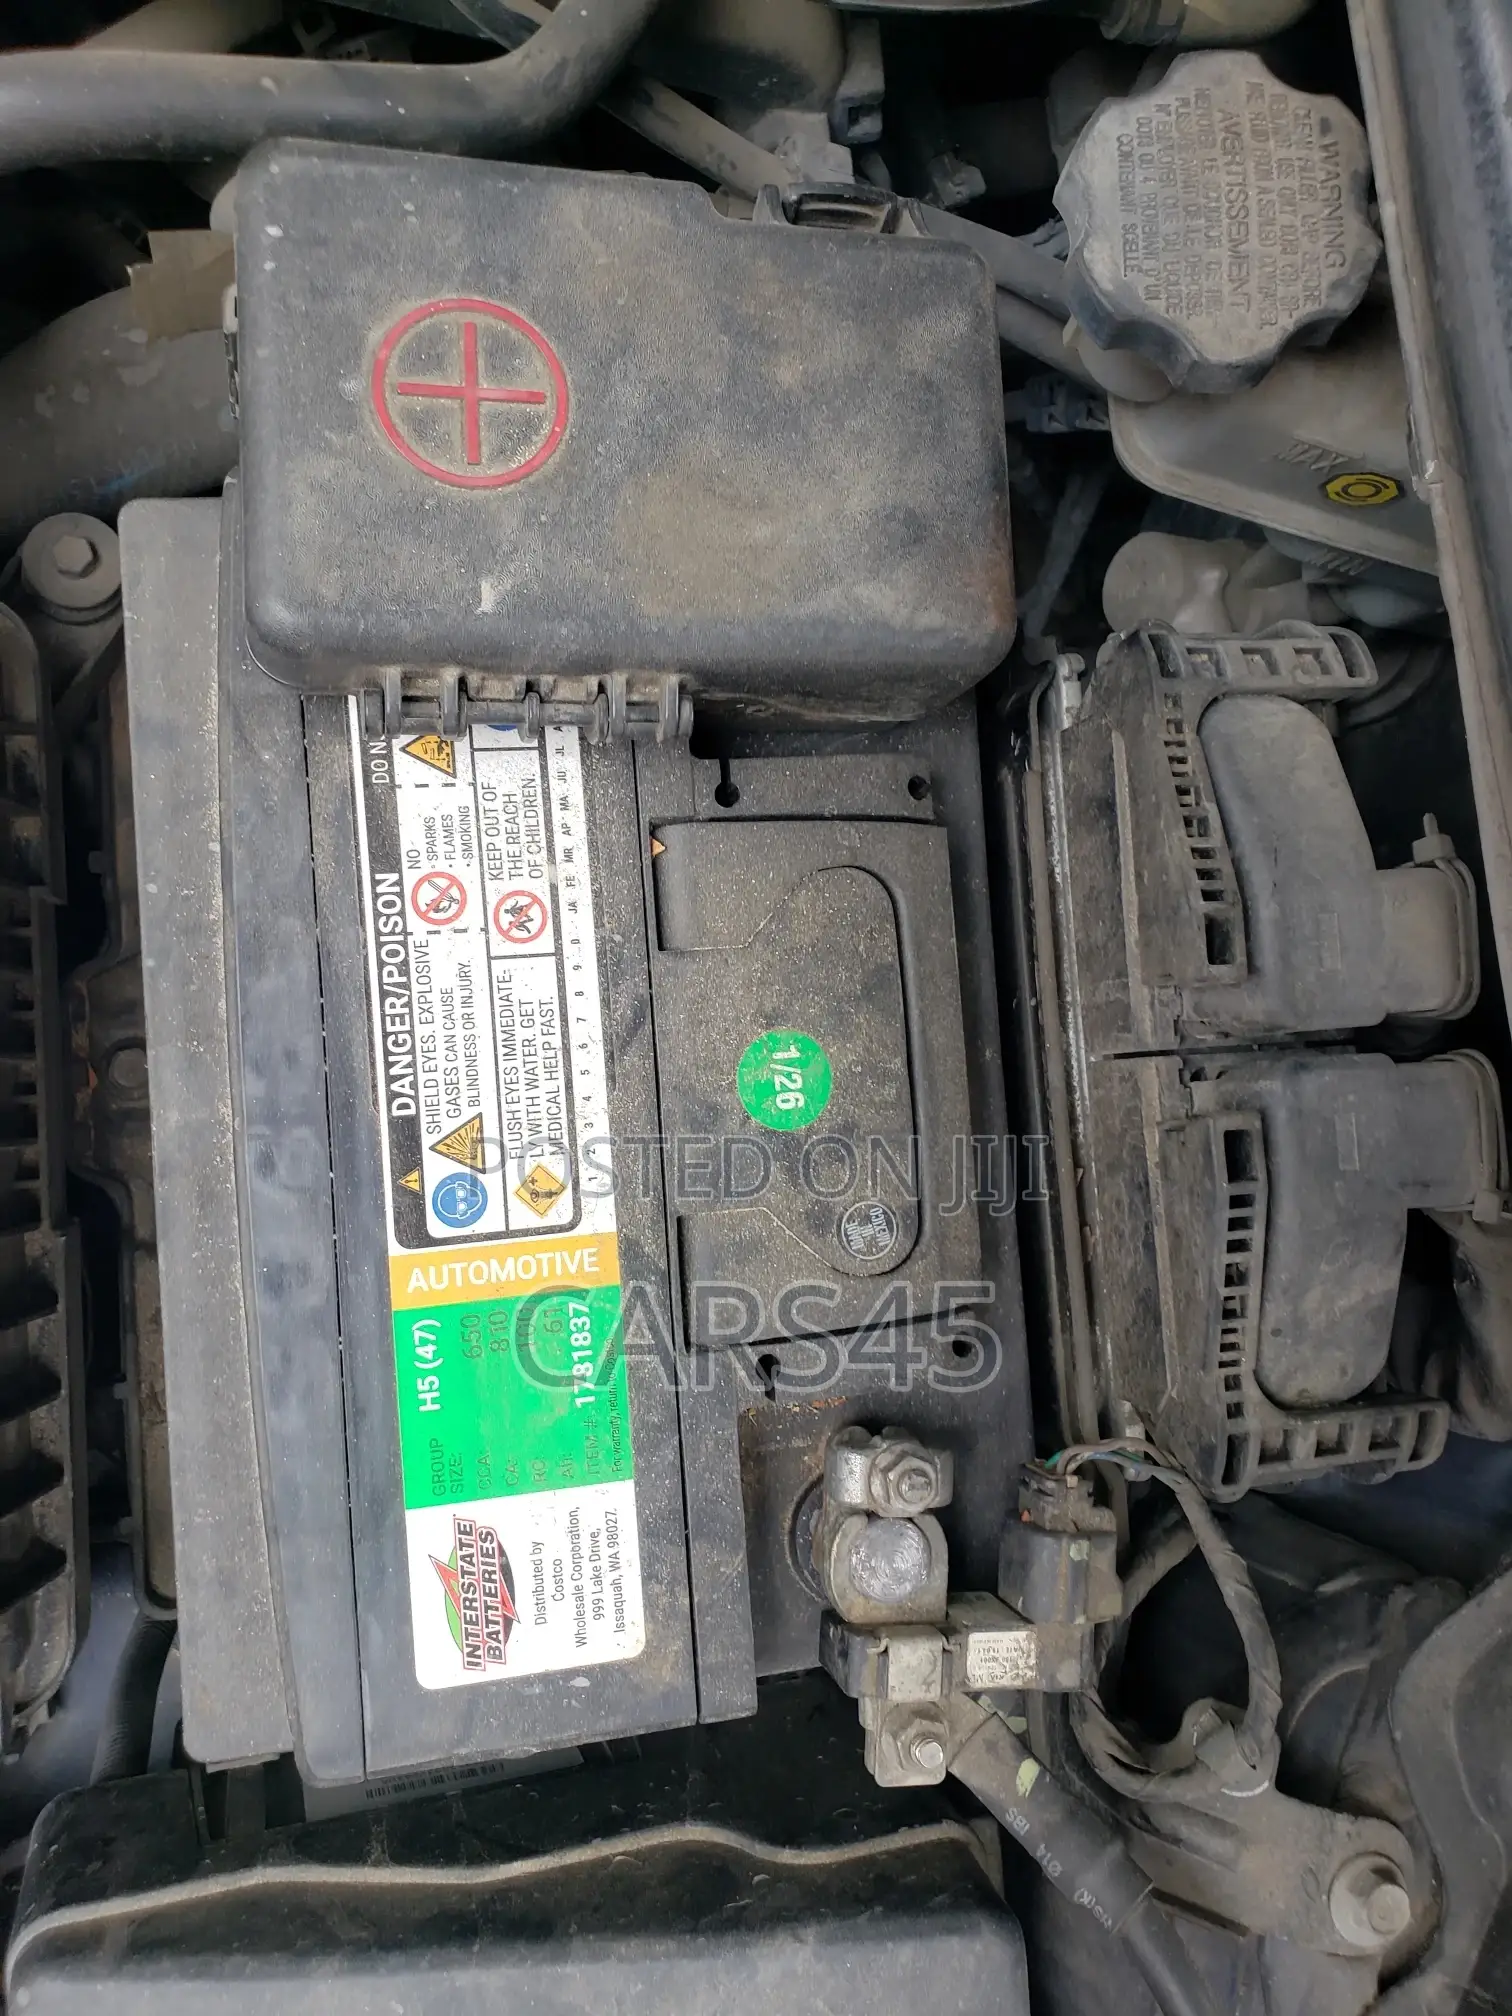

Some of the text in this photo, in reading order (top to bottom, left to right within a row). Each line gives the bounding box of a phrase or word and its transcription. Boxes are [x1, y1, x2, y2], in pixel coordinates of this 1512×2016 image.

[1117, 133, 1138, 215] CONTENANT
[1140, 153, 1158, 172] OU
[1141, 176, 1158, 184] 4
[1201, 157, 1218, 176] LE
[1163, 196, 1180, 225] QUE
[1218, 108, 1250, 313] AVERTISSEMENT
[1278, 187, 1297, 215] ONLY
[1319, 140, 1346, 269] WARNING
[1140, 193, 1160, 263] PROVENANT
[1163, 232, 1182, 252] DU
[1206, 261, 1221, 280] DE
[371, 760, 390, 784] DO
[555, 745, 565, 756] JL
[559, 795, 570, 810] MA
[424, 816, 438, 861] SPARKS
[441, 814, 456, 860] FLAMES
[459, 805, 473, 860] SMOKING
[481, 781, 504, 880] KEEP OUT OF
[502, 793, 523, 880] THE REACH
[522, 773, 543, 879] OF CHILDREN.
[561, 823, 572, 836] AP
[407, 849, 421, 870] NO
[564, 847, 574, 863] MR
[565, 876, 576, 887] FE
[567, 901, 578, 914] JA
[374, 872, 418, 1117] DANGER/POISON
[413, 939, 442, 1134] SHIELD EYES. EXPLOSIVE
[440, 987, 462, 1118] GASES CAN CAUSE
[457, 960, 480, 1108] BLINDNESS OR INJURY.
[497, 969, 525, 1160] FLUSH EYES IMMEDIATE-
[519, 1000, 544, 1157] LY WITH WATER. GET
[539, 996, 565, 1156] MEDICAL HELP FAST.
[770, 1044, 805, 1110] 1/26
[845, 1219, 864, 1250] MADE
[860, 1224, 874, 1237] IN
[870, 1207, 891, 1246] MEXICO
[406, 1246, 601, 1294] AUTOMOTIVE
[460, 1313, 483, 1359] 650
[488, 1310, 509, 1352] 810
[411, 1319, 444, 1412] H5 (47)
[568, 1301, 596, 1408] 1781837
[607, 1384, 618, 1411] return
[584, 1435, 600, 1475] ITEM
[609, 1413, 621, 1458] warranty,
[429, 1438, 447, 1496] GROUP
[450, 1452, 465, 1494] SIZE:
[611, 1459, 622, 1473] For
[529, 1541, 548, 1625] Distributed by
[551, 1559, 565, 1601] Costco
[567, 1507, 587, 1648] Wholesale Corporation,
[588, 1528, 606, 1620] 999 Lake Drive,
[607, 1551, 621, 1572] WA
[457, 1522, 482, 1668] INTERSTATE
[478, 1529, 503, 1661] BATTERIES
[610, 1575, 626, 1633] Issaquah,
